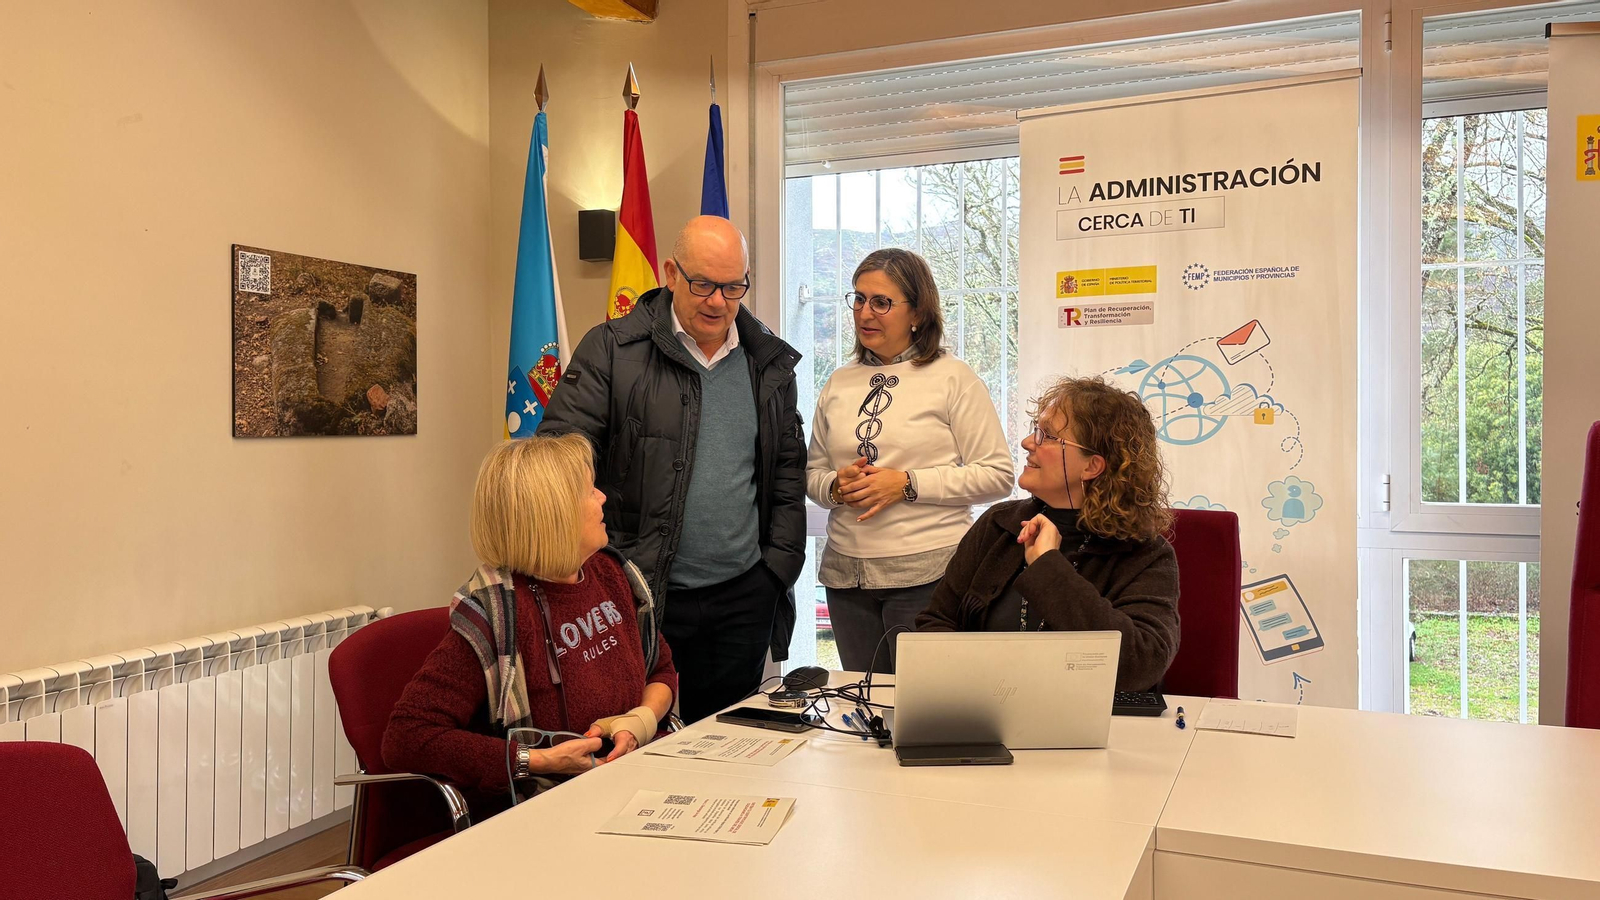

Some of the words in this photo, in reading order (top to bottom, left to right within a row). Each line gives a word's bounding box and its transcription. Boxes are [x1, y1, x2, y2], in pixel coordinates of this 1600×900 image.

[1058, 185, 1082, 206] LA
[1088, 157, 1321, 202] ADMINISTRACIÓN
[1078, 212, 1144, 232] CERCA
[1149, 209, 1173, 227] DE
[1179, 207, 1195, 225] TI
[1213, 268, 1254, 276] FEDERACIÓN
[1254, 265, 1289, 274] ESPAÑOLA
[1187, 272, 1205, 281] FEMP
[1255, 272, 1296, 280] PROVINCIAS
[1107, 304, 1152, 313] Recuperación,
[1084, 311, 1131, 319] Transformación
[583, 635, 618, 662] RULES
